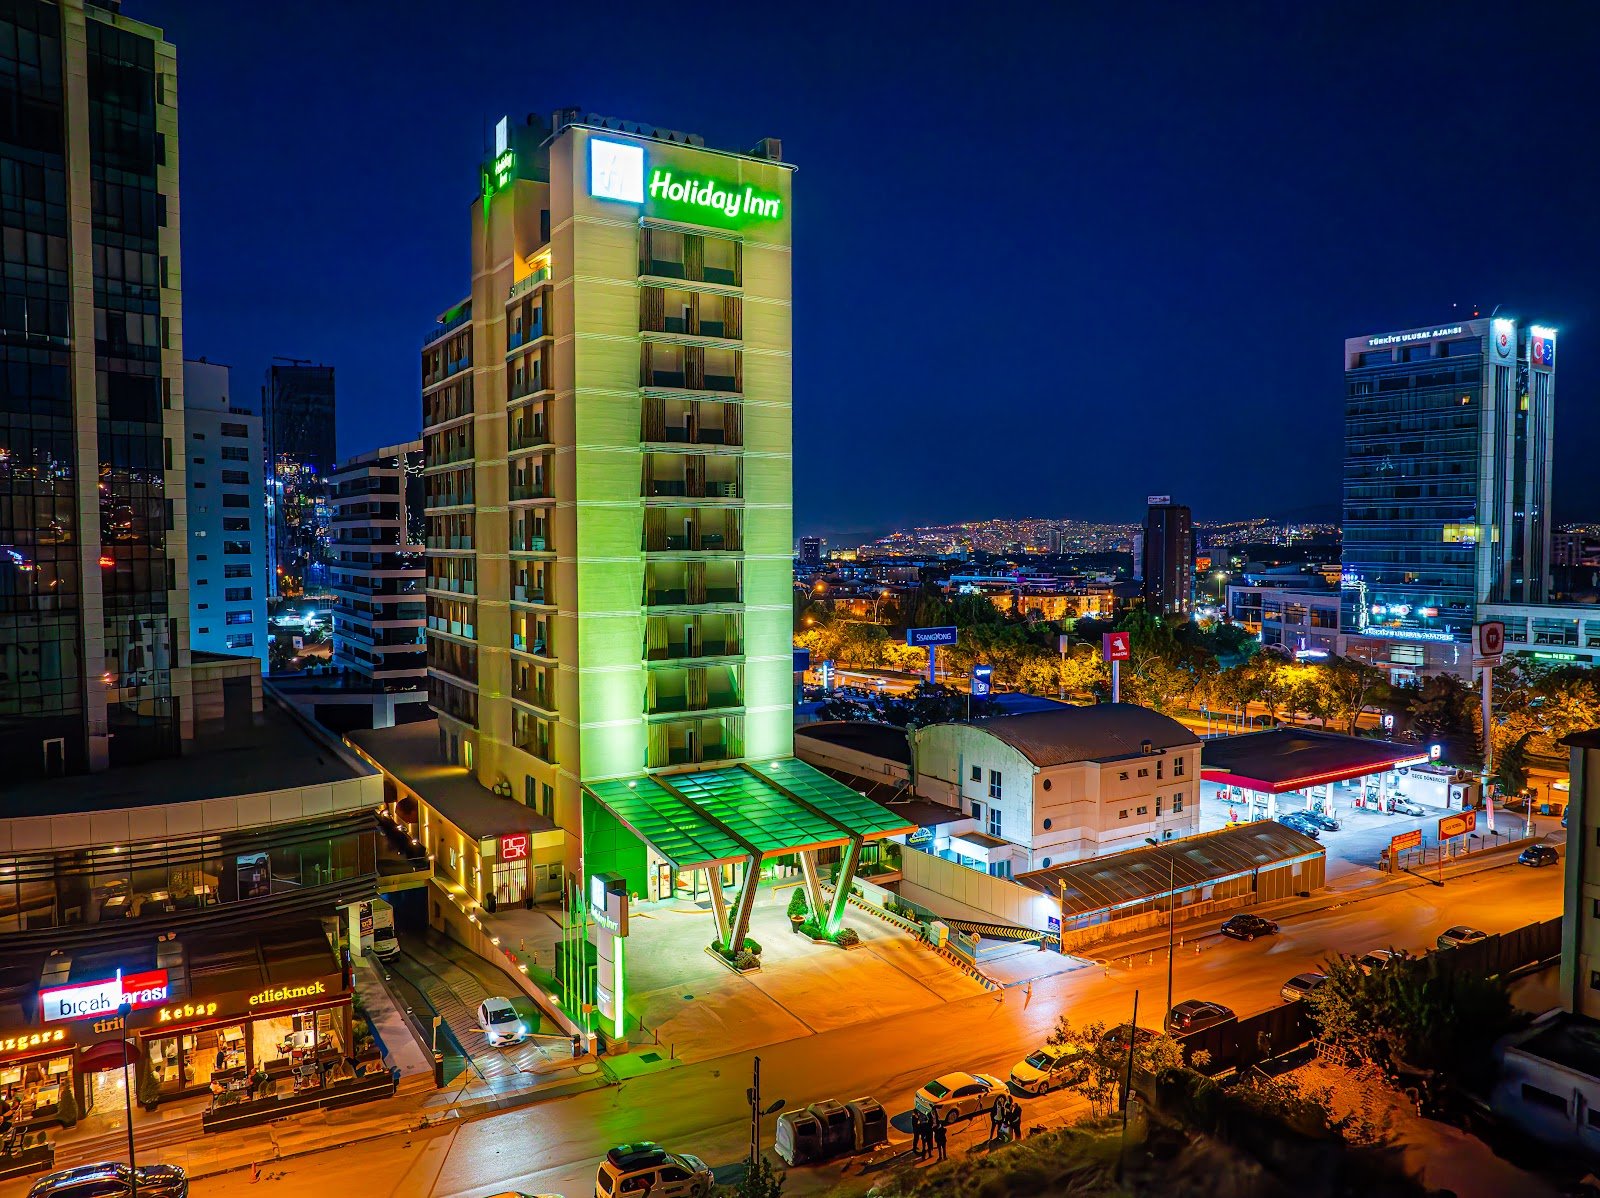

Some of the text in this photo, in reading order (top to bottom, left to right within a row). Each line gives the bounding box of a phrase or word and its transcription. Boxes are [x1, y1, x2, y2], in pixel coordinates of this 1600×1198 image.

[649, 170, 779, 218] Holiday Inn
[1368, 335, 1401, 346] TÜRKİYE
[1401, 331, 1431, 342] ULUSAL
[59, 992, 111, 1016] bıçak
[248, 981, 326, 1006] etliekmek
[159, 1002, 218, 1022] kebap
